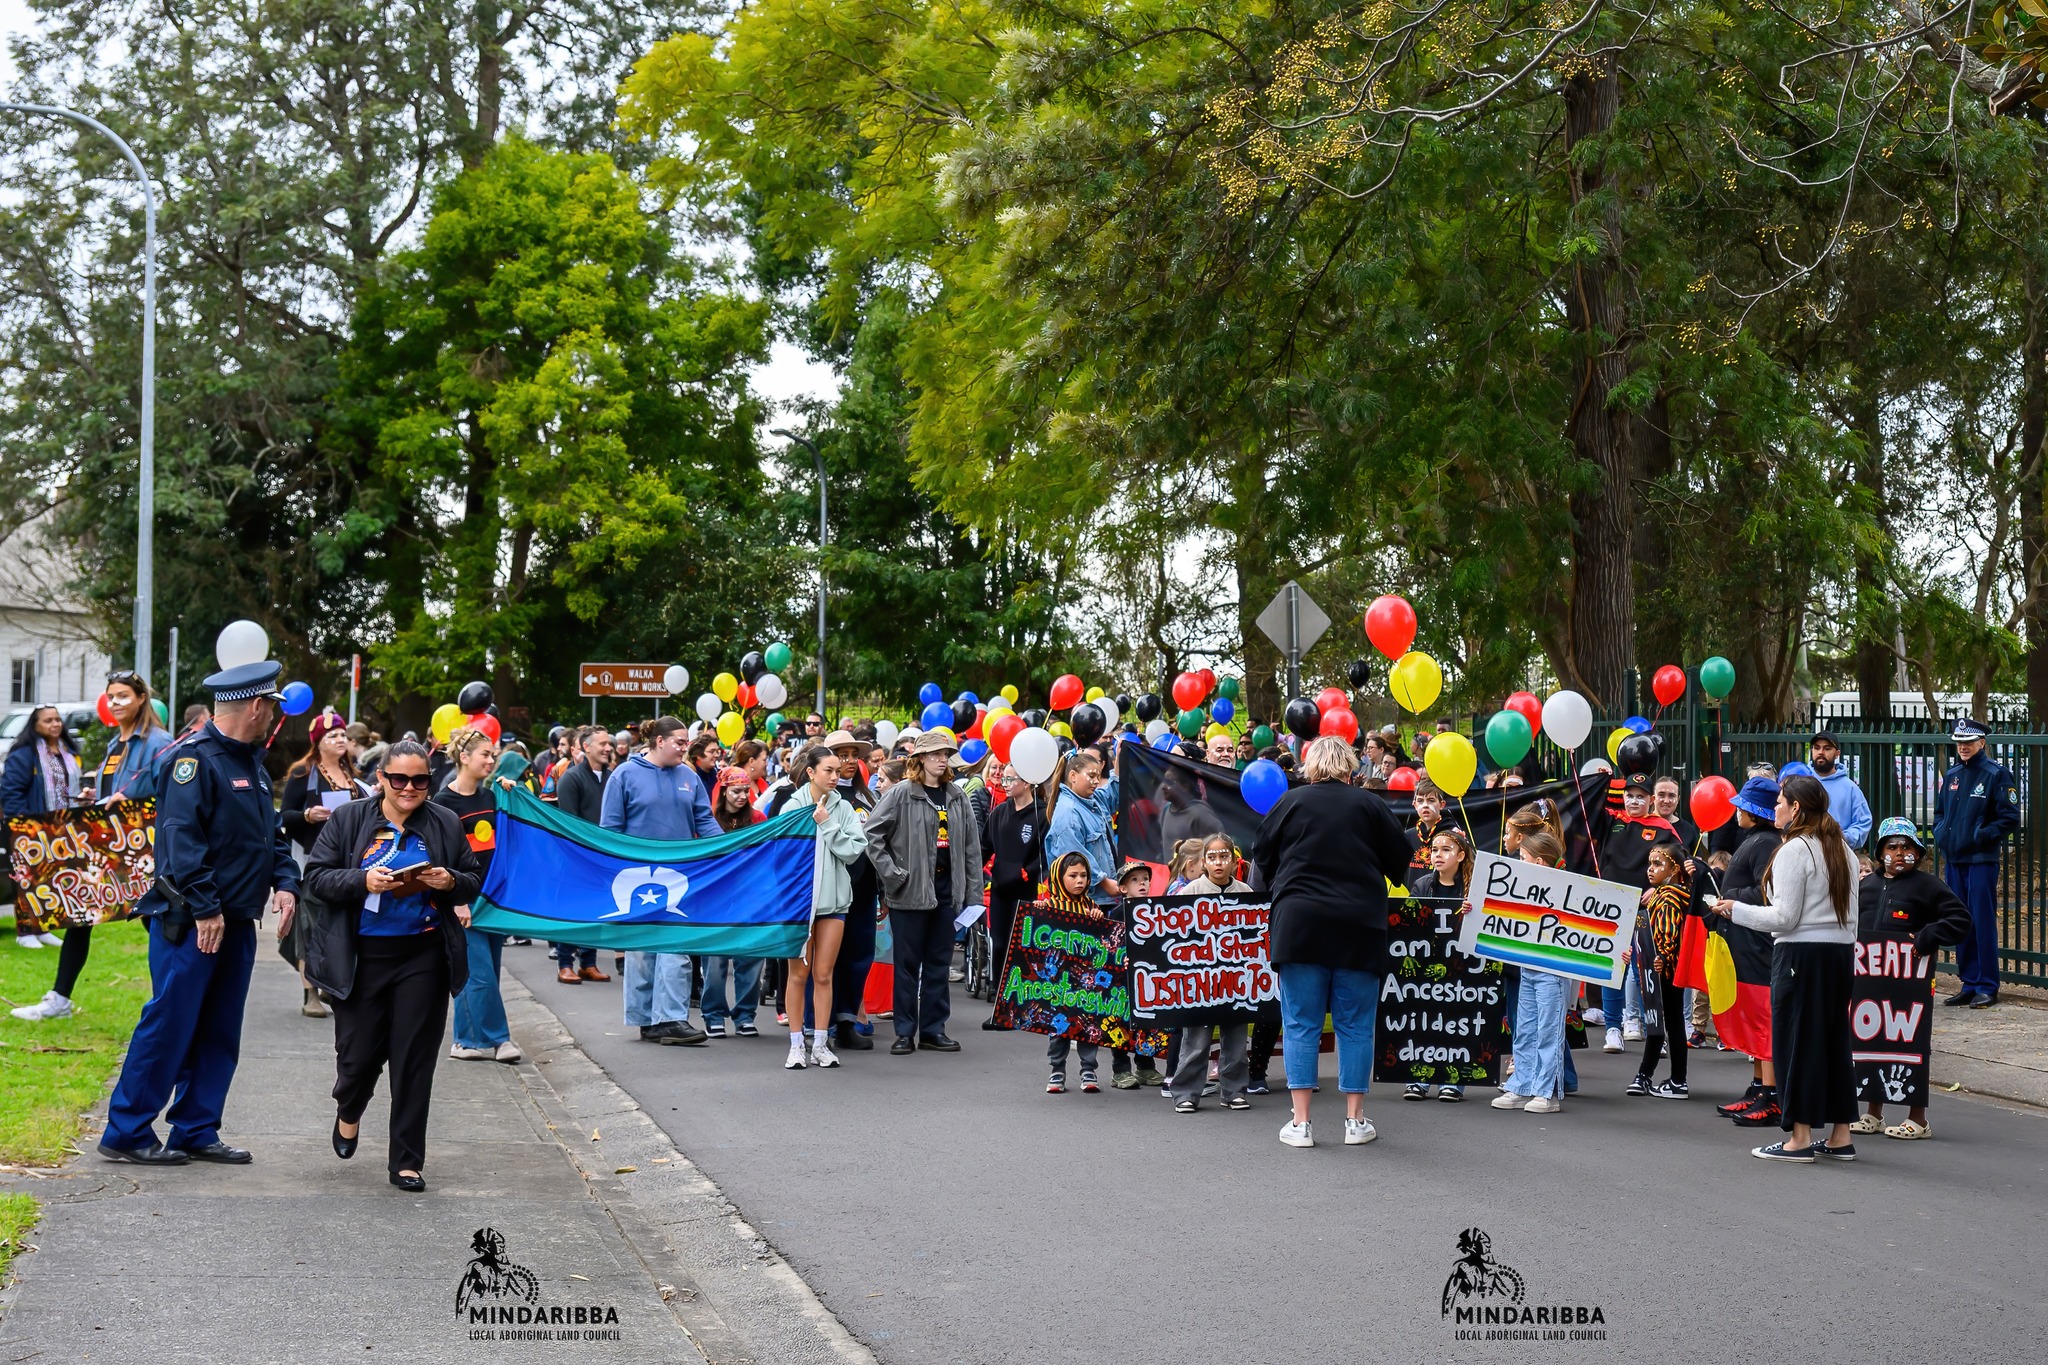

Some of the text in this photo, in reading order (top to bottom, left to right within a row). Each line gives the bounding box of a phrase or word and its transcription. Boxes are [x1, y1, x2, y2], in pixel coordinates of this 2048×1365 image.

[614, 681, 667, 692] WATER WORKS
[628, 669, 654, 679] WALKA
[15, 823, 94, 866] Blak
[1486, 861, 1622, 920] BLAK, LOUD
[1133, 904, 1194, 938] Stop
[1434, 908, 1453, 934] I
[1482, 914, 1530, 938] AND
[1537, 913, 1614, 954] PROUD
[1021, 915, 1034, 948] I
[1033, 924, 1108, 969] carry
[1167, 933, 1217, 966] and
[1389, 940, 1431, 957] am
[1135, 966, 1247, 1010] LISTENING
[1848, 999, 1924, 1042] OW
[1399, 1039, 1470, 1063] dream
